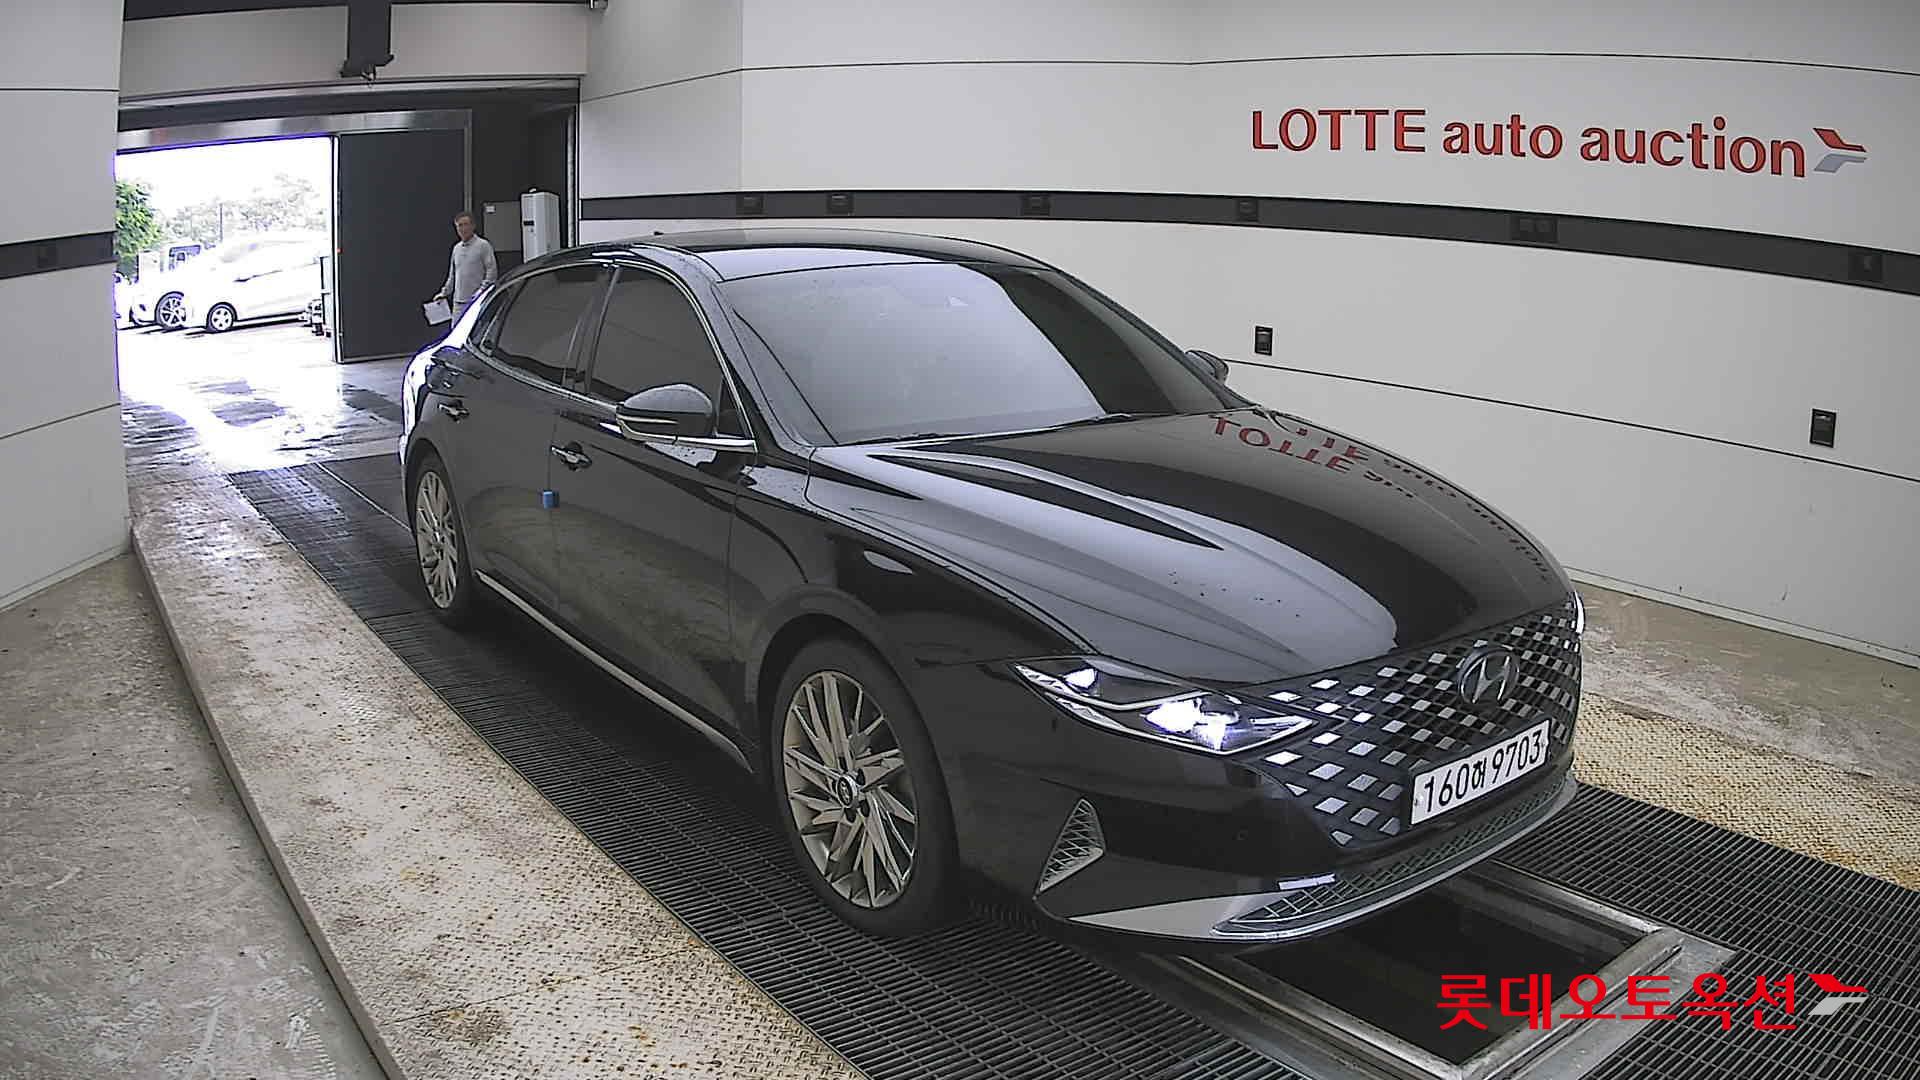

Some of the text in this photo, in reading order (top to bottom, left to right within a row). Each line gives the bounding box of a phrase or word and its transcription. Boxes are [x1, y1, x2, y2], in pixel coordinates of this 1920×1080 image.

[1252, 108, 1806, 178] LOTTE auto auction
